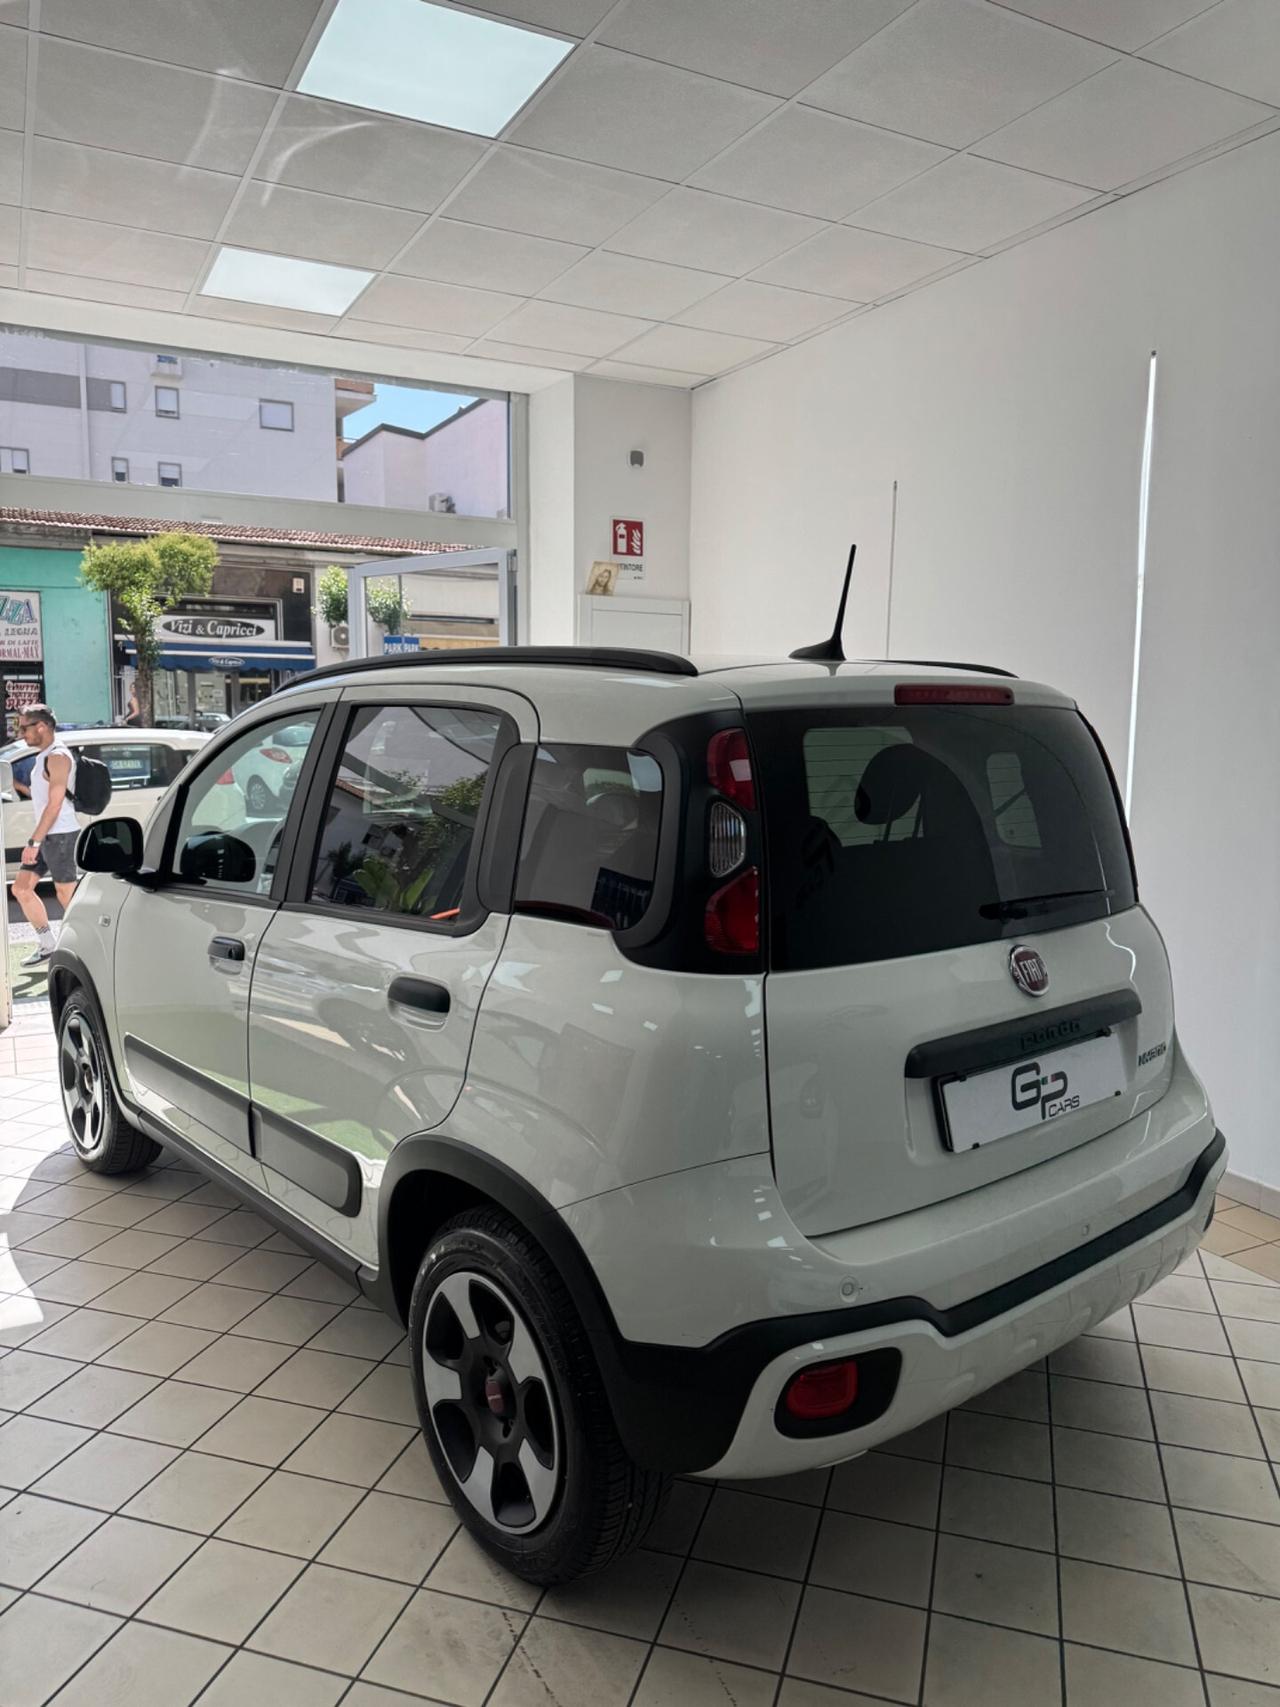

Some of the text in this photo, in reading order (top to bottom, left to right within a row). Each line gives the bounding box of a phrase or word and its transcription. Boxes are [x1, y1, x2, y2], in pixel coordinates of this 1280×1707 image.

[170, 620, 257, 639] Vizi & Capricci
[1018, 957, 1045, 983] FIAT
[1048, 1095, 1080, 1118] CARS
